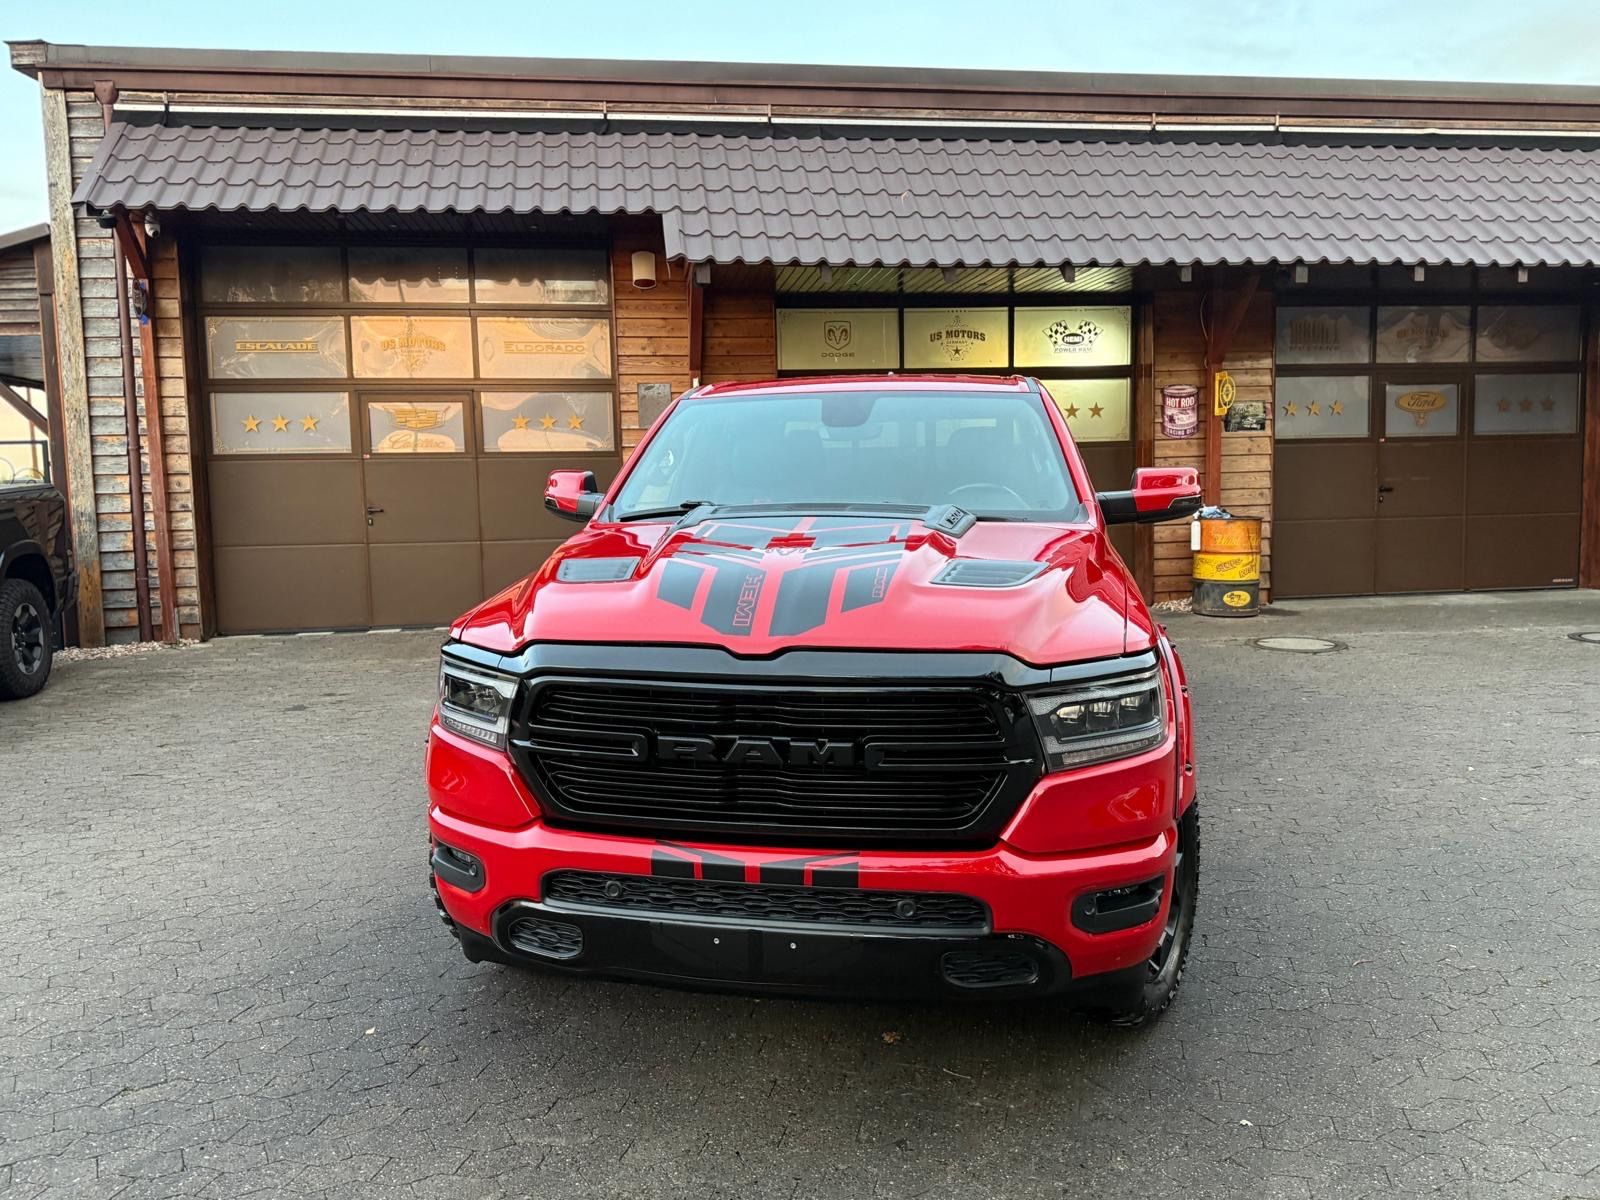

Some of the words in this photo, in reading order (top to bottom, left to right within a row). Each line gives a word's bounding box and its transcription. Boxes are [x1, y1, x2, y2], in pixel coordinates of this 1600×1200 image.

[930, 332, 943, 342] US
[945, 329, 986, 342] MOTORS
[1063, 335, 1083, 343] HEMI
[236, 342, 318, 350] ESCALADE
[504, 343, 585, 352] ELDORADO
[1166, 397, 1180, 408] HOT
[1407, 392, 1439, 409] Ford
[732, 574, 763, 626] HEMI
[656, 734, 856, 767] RAM
